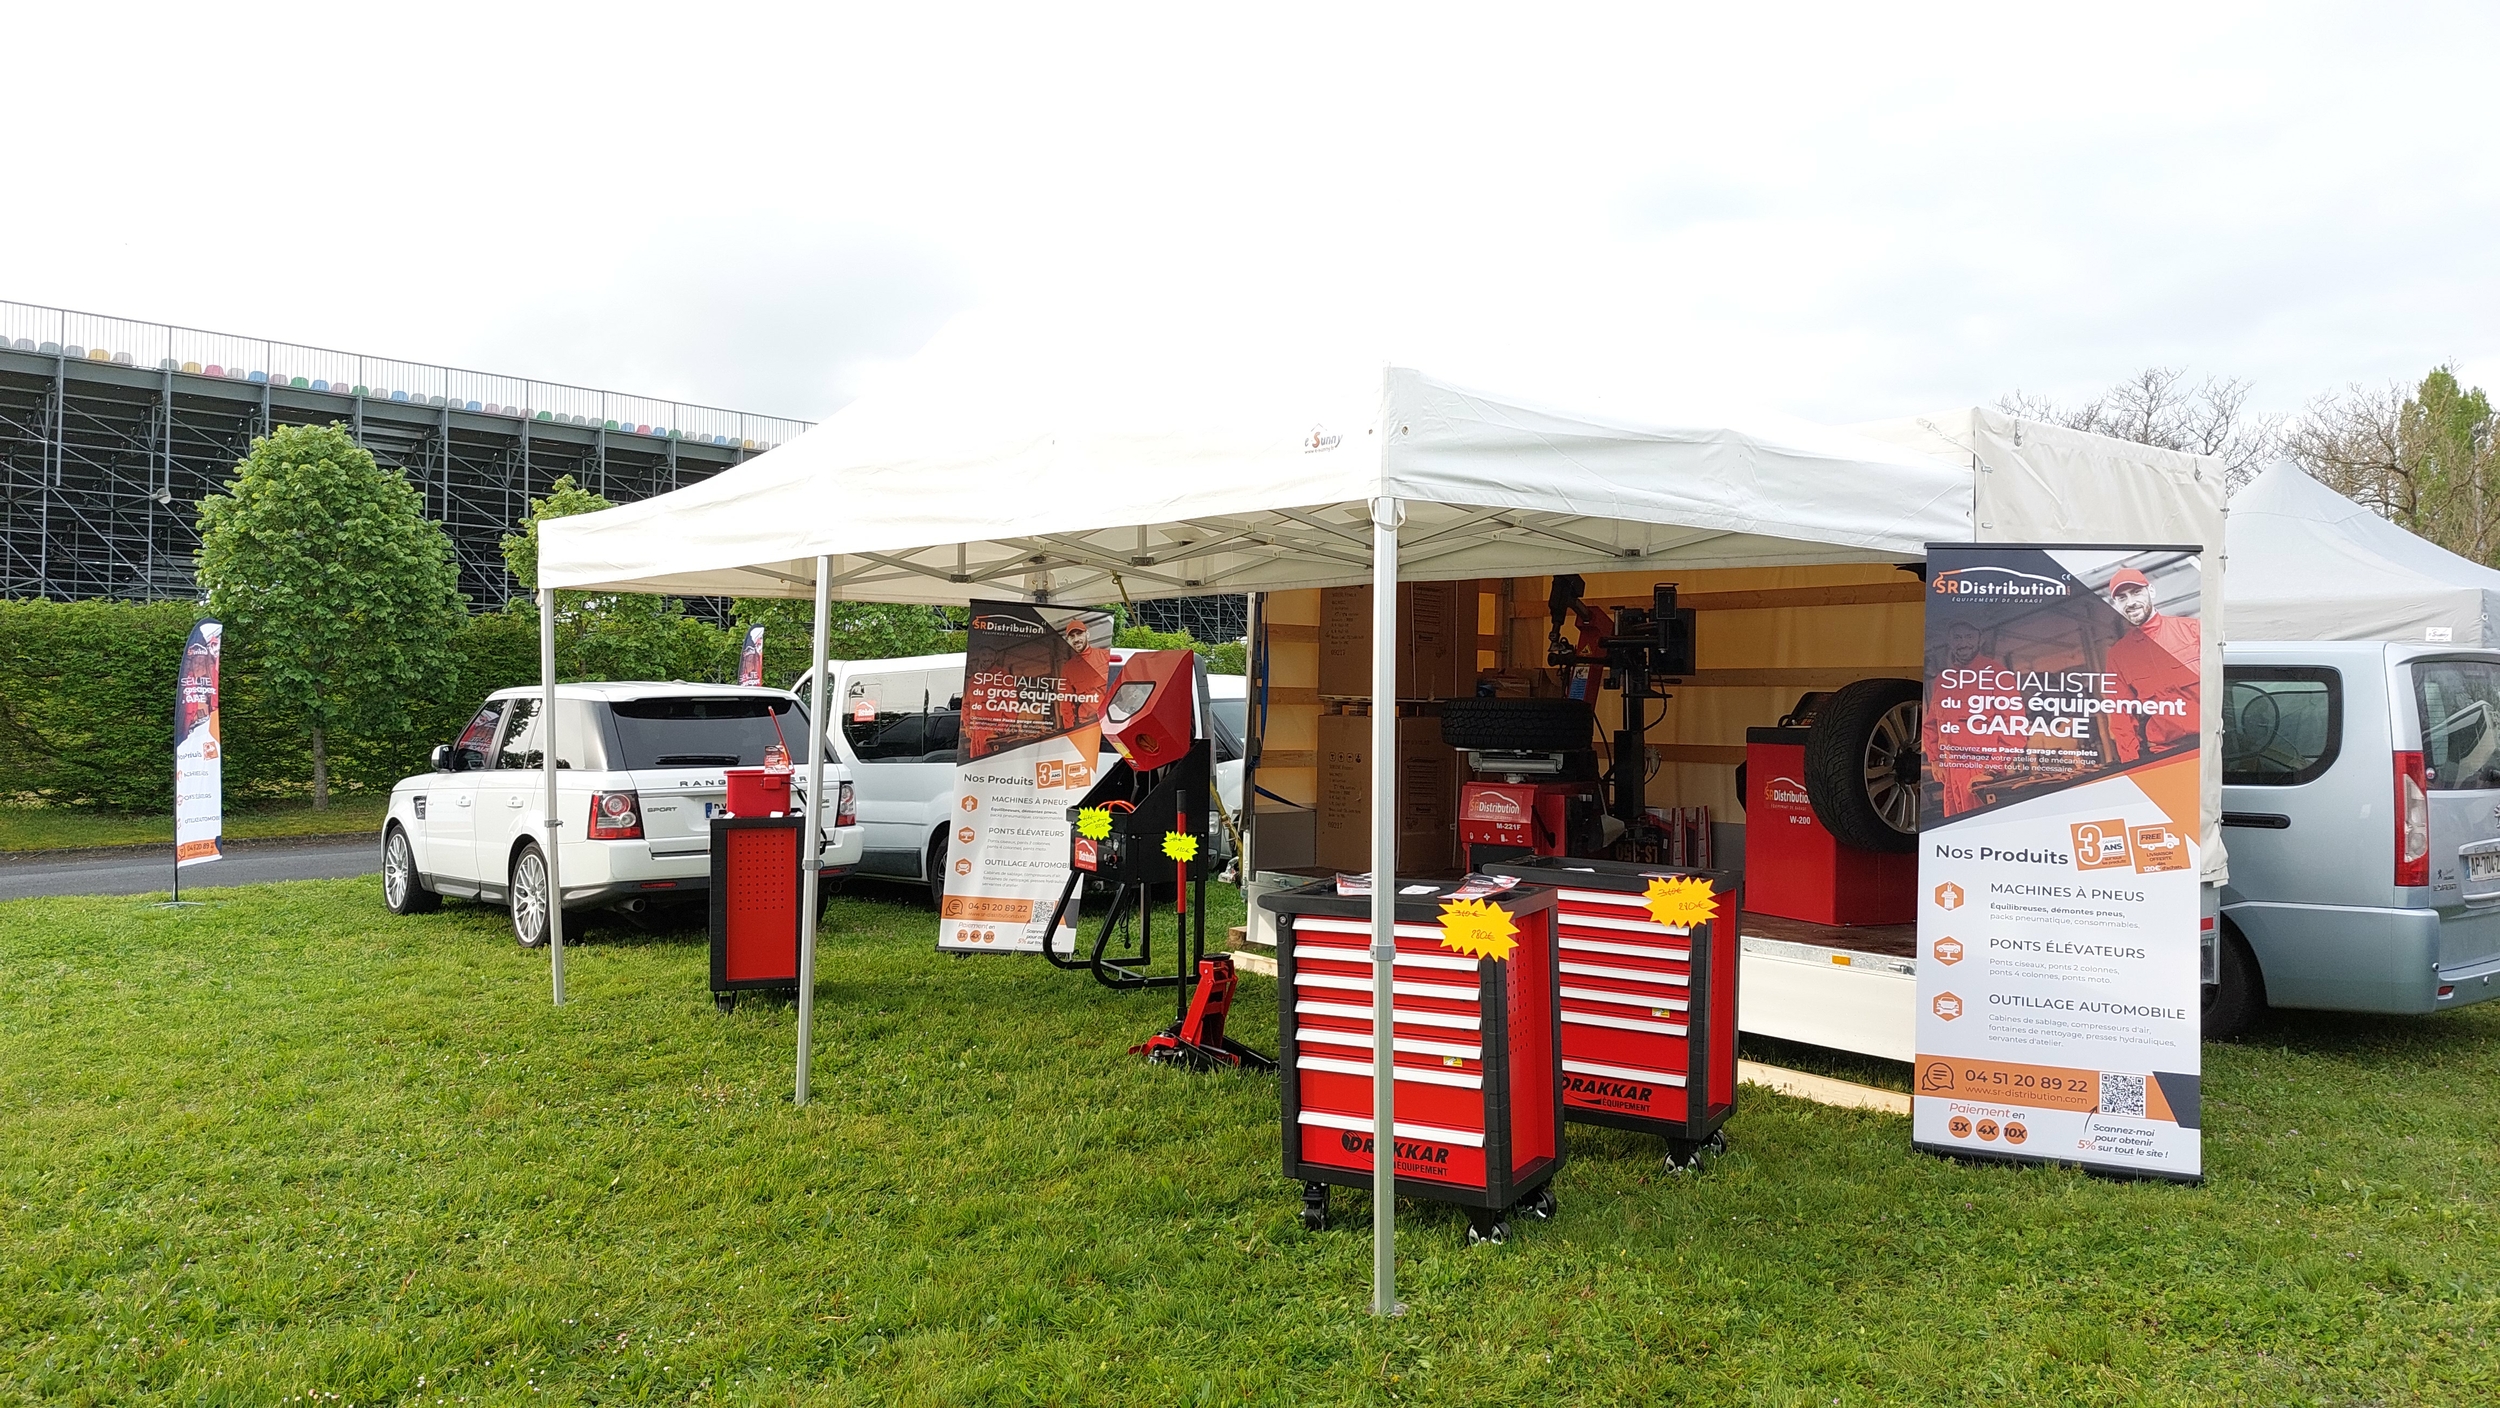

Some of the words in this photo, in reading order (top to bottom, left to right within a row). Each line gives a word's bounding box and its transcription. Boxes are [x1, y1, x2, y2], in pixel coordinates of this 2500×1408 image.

[1935, 579, 2067, 596] SRDistribution
[973, 620, 1044, 634] SRDistribution
[973, 671, 1067, 691] SPÉCIALISTE
[1940, 665, 2118, 694] SPÉCIALISTE
[972, 688, 984, 697] du
[987, 687, 1017, 699] gros
[1019, 688, 1100, 704] équipement
[971, 702, 983, 711] de
[985, 700, 1051, 715] GARAGE
[1940, 697, 1962, 709] du
[1967, 694, 2023, 714] gros
[2027, 692, 2187, 717] équipement
[1940, 721, 1960, 734] de
[1966, 714, 2090, 739] GARAGE
[1939, 743, 1981, 752] Découvrez
[1998, 746, 2025, 754] Packs
[2026, 747, 2056, 756] garage
[2058, 748, 2098, 758] complets
[1948, 752, 1989, 762] aménagez
[1990, 754, 2012, 762] votre
[2012, 755, 2037, 763] atelier
[2051, 756, 2096, 766] mécanique
[1039, 763, 1052, 786] 3
[1939, 761, 1983, 769] automobile
[2004, 763, 2021, 771] tout
[2022, 763, 2030, 771] le
[679, 779, 727, 787] RANG
[963, 773, 985, 783] Nos
[987, 774, 1034, 786] Produits
[991, 795, 1034, 805] MACHINES
[1034, 796, 1041, 805] À
[1042, 798, 1069, 806] PNEUS
[1765, 789, 1810, 804] SRDistributio
[1469, 801, 1520, 815] SRDistribution
[1496, 822, 1522, 831] M-221F
[1789, 815, 1811, 825] W-200
[988, 827, 1015, 836] PONTS
[1016, 827, 1065, 837] ÉLÉVATEURS
[2140, 832, 2162, 841] FREE
[2078, 824, 2103, 866] 3
[2103, 842, 2123, 852] ANS
[1935, 844, 1974, 860] Nos
[1980, 846, 2069, 865] Produits
[984, 858, 1028, 867] OUTILLAGE
[1029, 860, 1070, 869] AUTOMOBI
[1990, 882, 2072, 899] MACHINES
[2075, 885, 2087, 899] À
[2091, 888, 2145, 903] PNEUS
[968, 902, 979, 910] 04
[981, 902, 990, 911] 51
[991, 903, 1003, 911] 20
[1005, 904, 1016, 912] 89
[1017, 905, 1028, 913] 22
[1990, 901, 2049, 914] Équilibreuses,
[2050, 905, 2094, 916] démontes
[2096, 909, 2126, 919] pneus,
[1990, 911, 2014, 922] packs
[2015, 914, 2073, 926] pneumatique,
[2074, 917, 2140, 929] consommables.
[1990, 938, 2041, 952] PONTS
[2046, 939, 2146, 959] ÉLÉVATEURS
[1989, 958, 2013, 967] Ponts
[2014, 960, 2047, 970] ciseaux,
[2048, 963, 2072, 972] ponts
[2073, 964, 2079, 972] 2
[2080, 964, 2120, 975] colonnes,
[1989, 968, 2013, 978] ponts
[2021, 970, 2060, 981] colonnes,
[2061, 974, 2086, 983] ponts
[2087, 975, 2112, 984] moto.
[1989, 993, 2075, 1011] OUTILLAGE
[2079, 1001, 2186, 1020] AUTOMOBILE
[1988, 1013, 2022, 1024] Cabines
[2023, 1016, 2034, 1025] de
[2035, 1017, 2070, 1029] sablage,
[2071, 1021, 2130, 1034] compresseurs
[1988, 1024, 2027, 1034] fontaines
[2028, 1026, 2039, 1035] de
[2040, 1028, 2084, 1040] nettoyage,
[2085, 1032, 2118, 1043] presses
[2119, 1034, 2177, 1048] hydrauliques,
[1988, 1034, 2028, 1044] servantes
[1964, 1069, 1988, 1084] 04
[1992, 1071, 2008, 1086] 51
[2013, 1073, 2035, 1088] 20
[2040, 1075, 2063, 1090] 89
[2067, 1078, 2088, 1093] 22
[1964, 1085, 2088, 1105] www.sr-distribution.com
[1602, 1096, 1651, 1113] ÉQUIPEMENT
[1949, 1102, 2010, 1119] Paiement
[2011, 1111, 2026, 1120] en
[1951, 1121, 1970, 1133] 3X
[1978, 1124, 1997, 1136] 4X
[2003, 1127, 2027, 1140] 10X
[2093, 1122, 2155, 1138] Scannez-moi
[2077, 1138, 2096, 1151] 5%
[2097, 1145, 2113, 1154] sur
[2114, 1145, 2134, 1156] tout
[2136, 1146, 2145, 1156] le
[2146, 1147, 2162, 1158] site
[2094, 1134, 2117, 1146] pour
[2118, 1136, 2154, 1147] obtenir
[1348, 1136, 1449, 1164] DRKKAR
[1397, 1161, 1449, 1177] ÉQUIPEMENT
